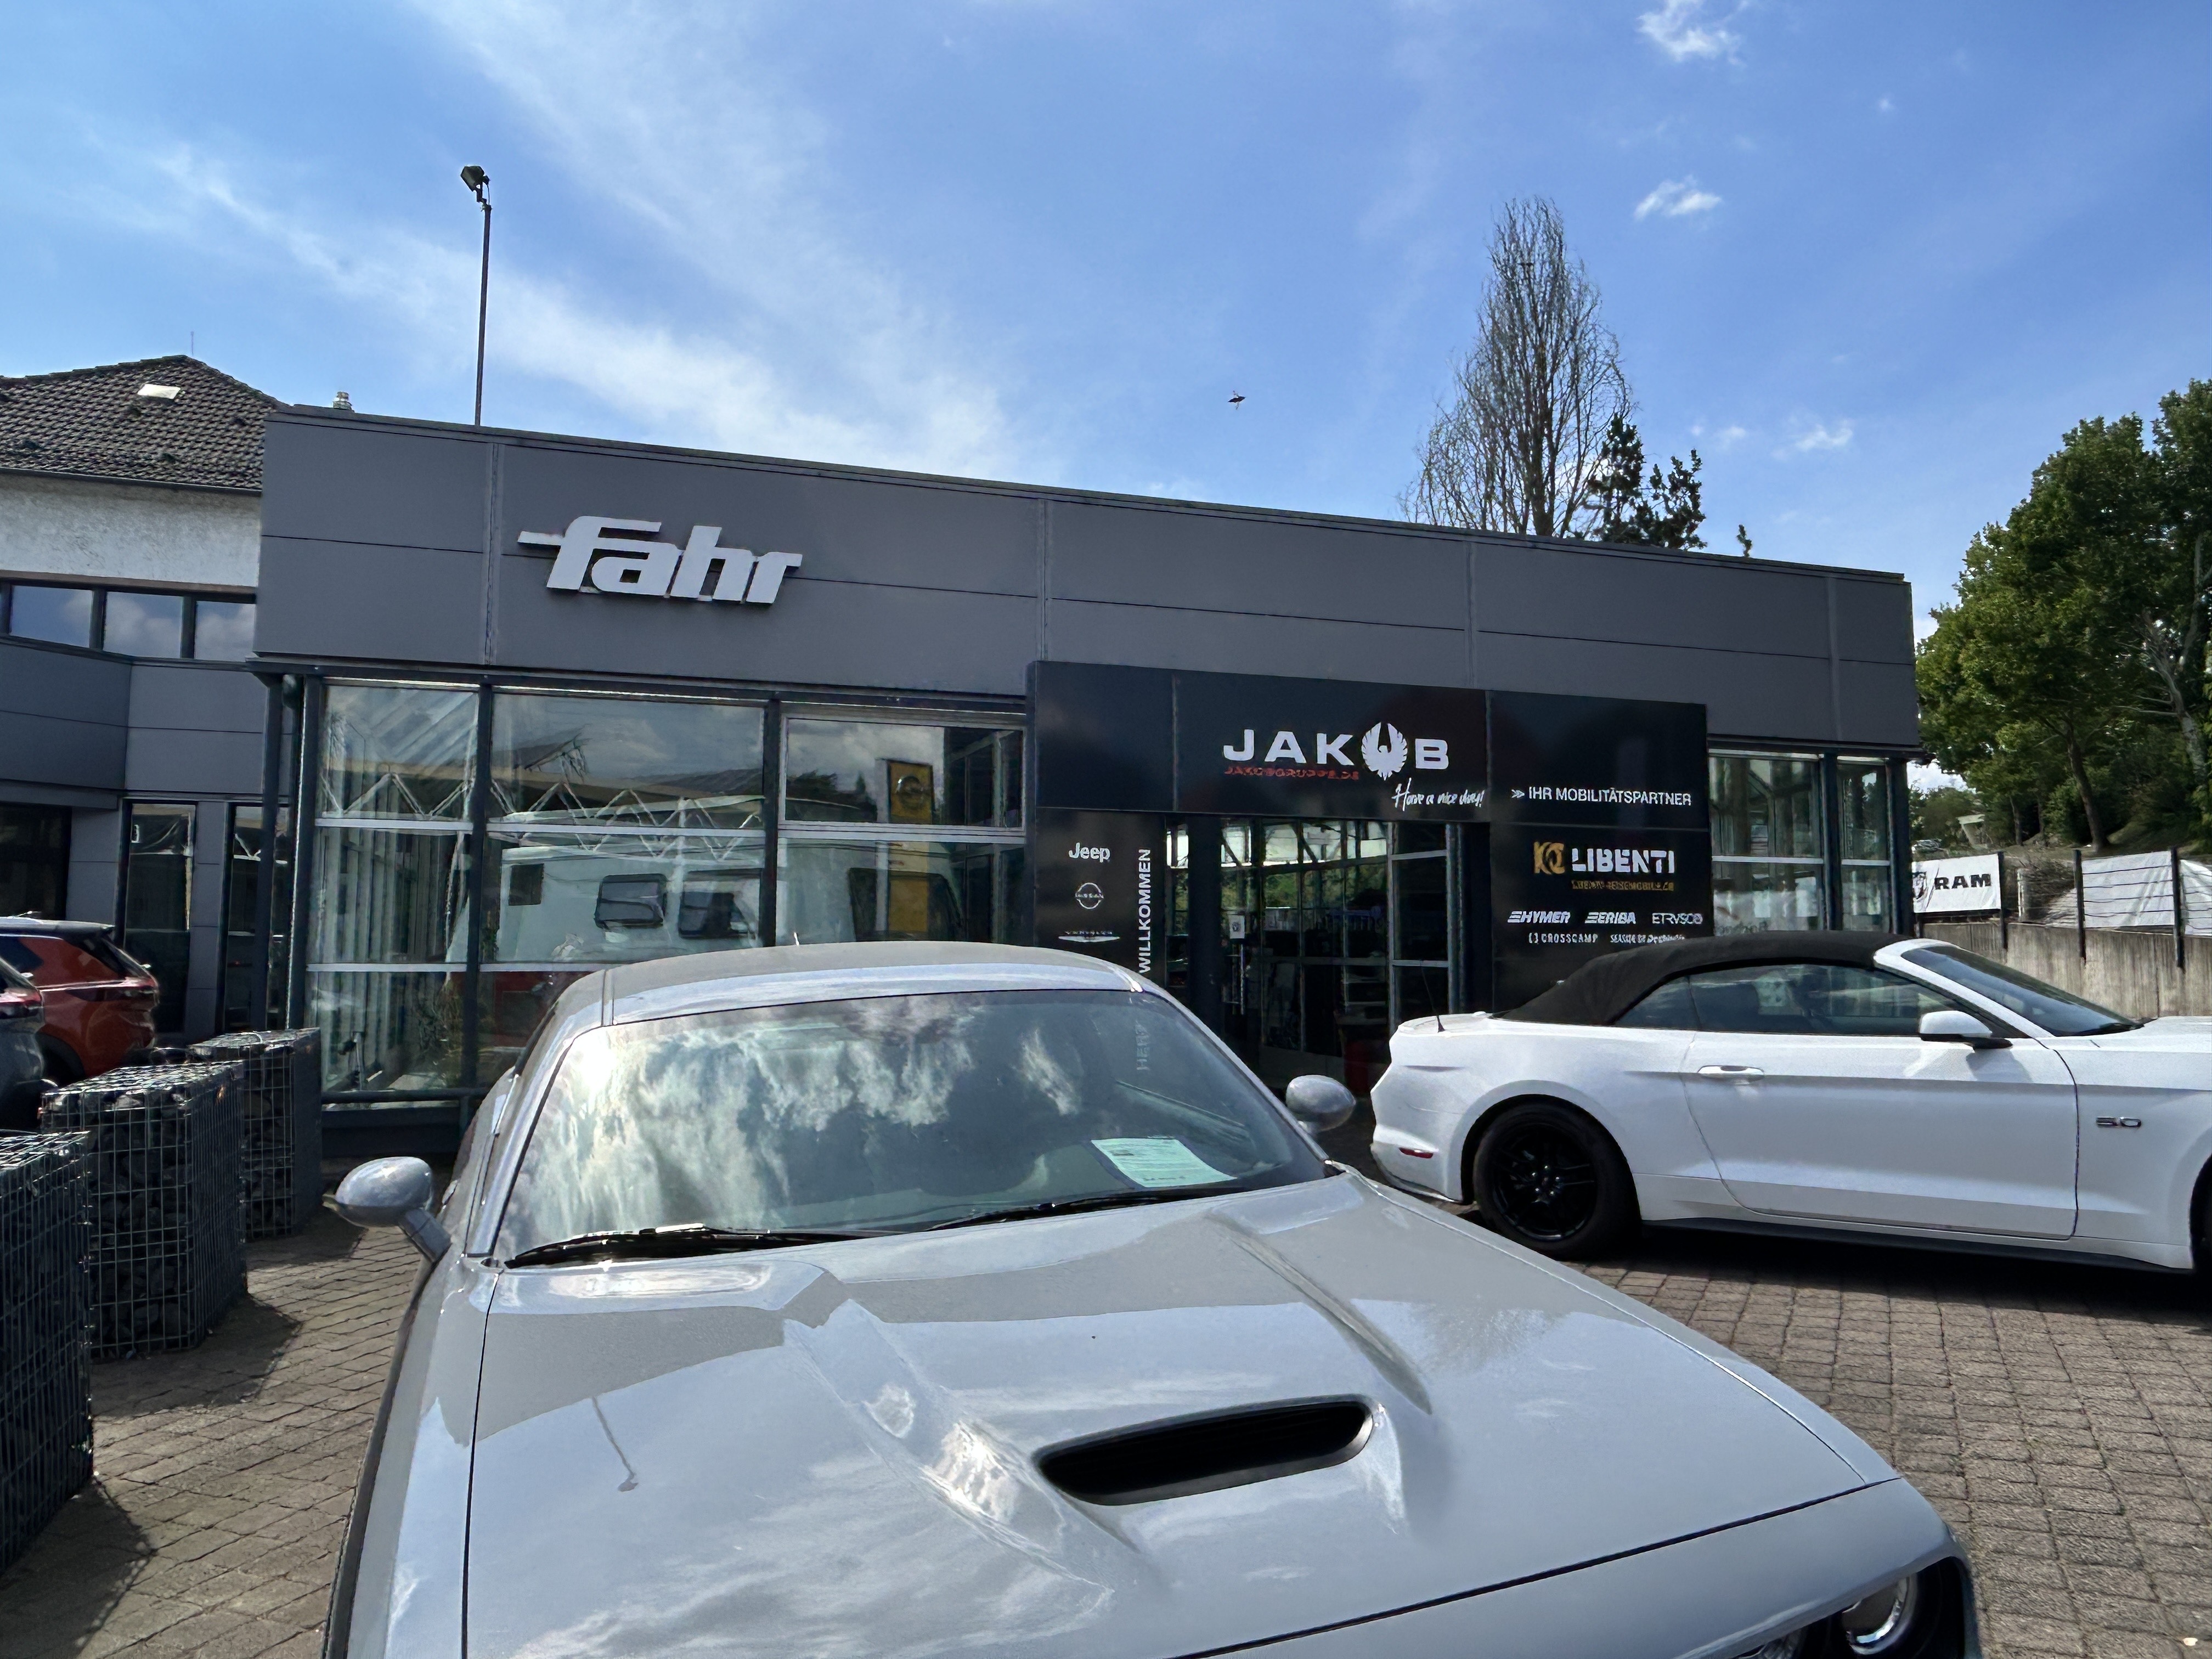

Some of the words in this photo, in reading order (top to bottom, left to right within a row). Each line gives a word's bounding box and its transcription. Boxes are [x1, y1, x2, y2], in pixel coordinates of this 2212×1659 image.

[517, 515, 803, 604] fahr
[1426, 793, 1435, 805] a
[1528, 786, 1553, 800] IHR
[1555, 787, 1692, 806] MOBILITÄTSPARTNER
[1069, 842, 1110, 863] Jeep
[1572, 848, 1675, 874] LIBENTI
[1934, 873, 1991, 890] RAM
[1138, 849, 1151, 974] WILLKOMMEN
